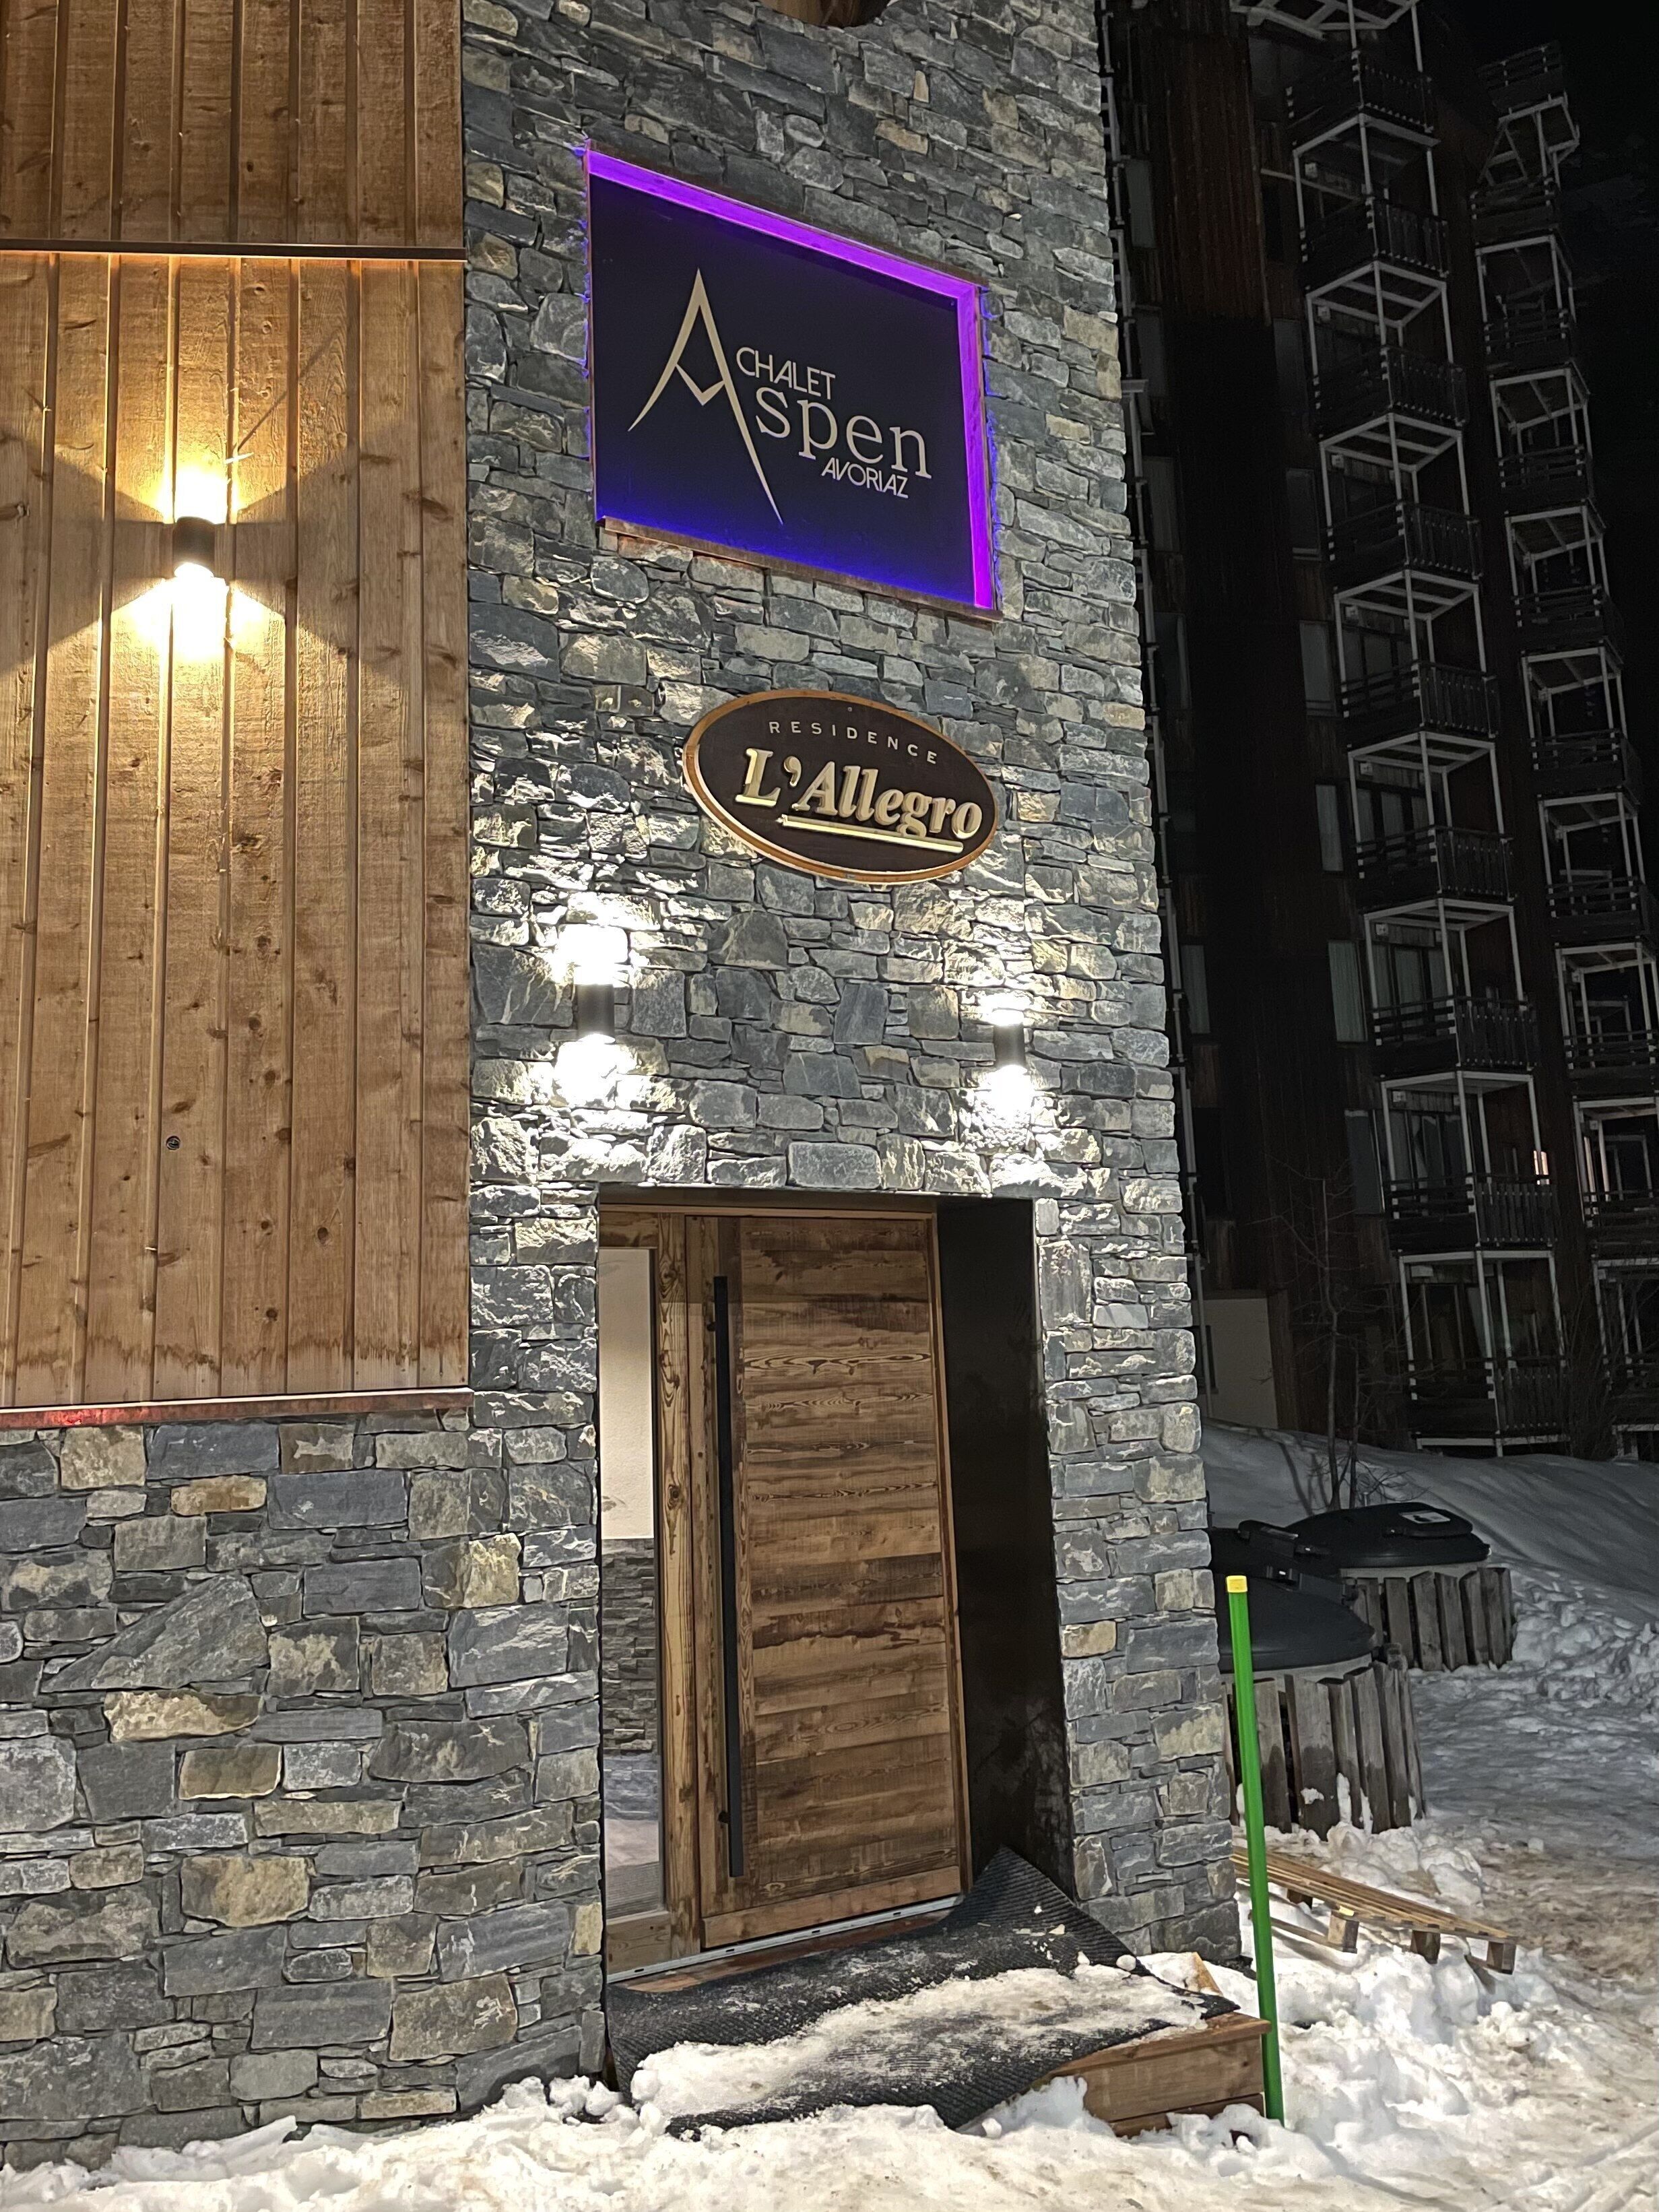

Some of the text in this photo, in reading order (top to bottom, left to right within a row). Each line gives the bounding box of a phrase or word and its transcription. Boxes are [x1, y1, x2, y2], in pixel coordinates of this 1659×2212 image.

[628, 268, 932, 525] Aspen
[736, 347, 835, 399] CHALET
[821, 457, 909, 498] AVORIAZ
[769, 721, 937, 765] RESIDENCE
[735, 748, 983, 839] L'Allegro
